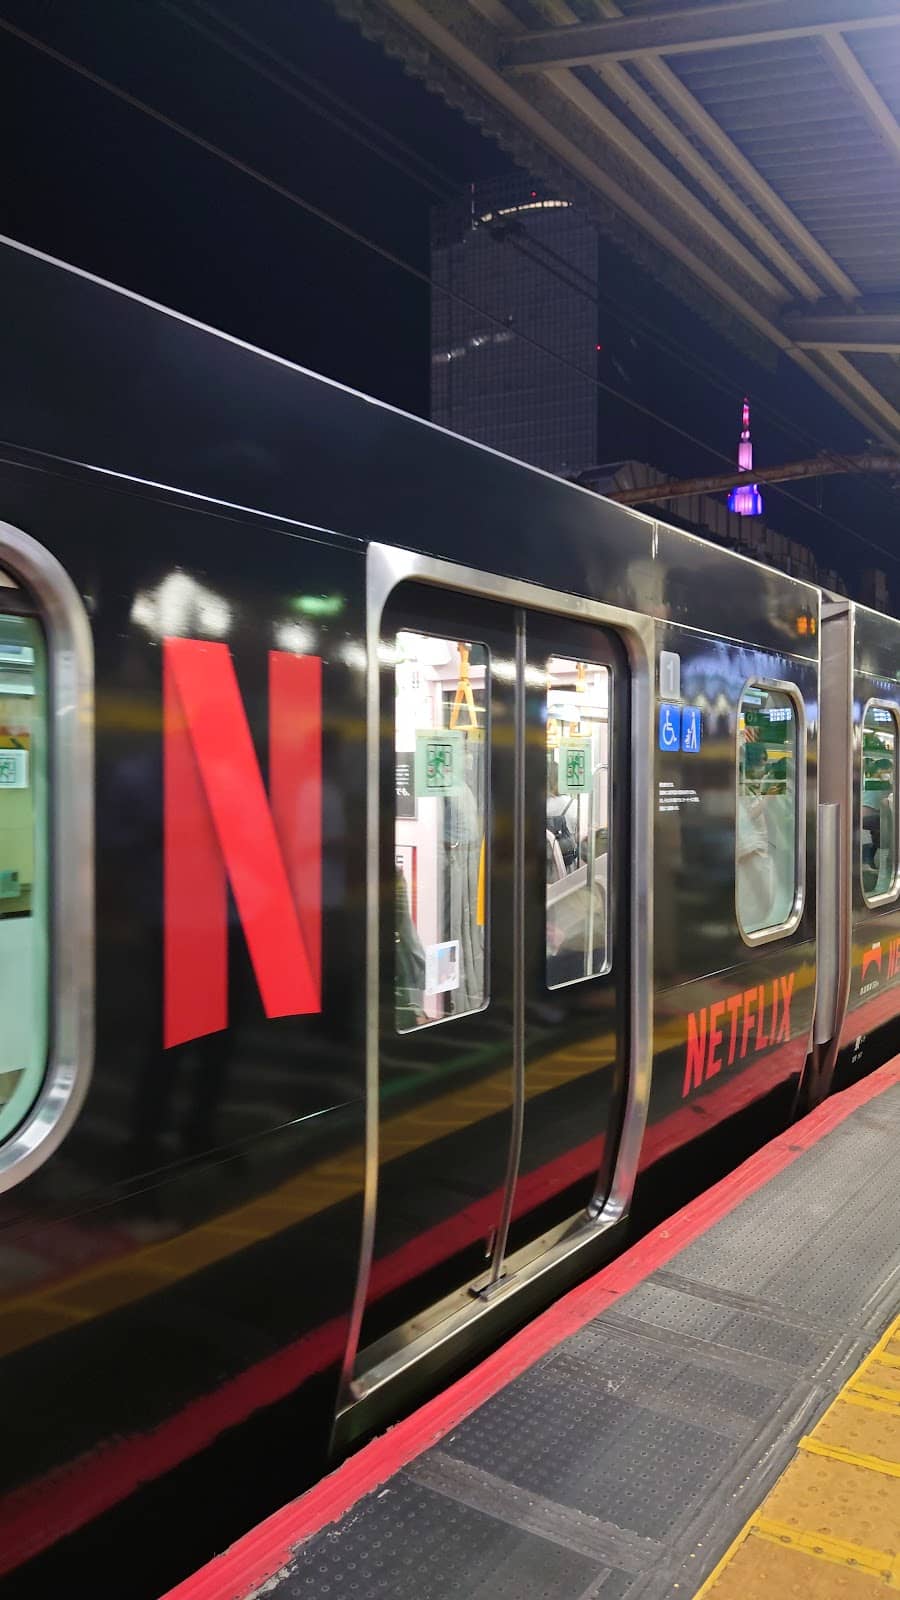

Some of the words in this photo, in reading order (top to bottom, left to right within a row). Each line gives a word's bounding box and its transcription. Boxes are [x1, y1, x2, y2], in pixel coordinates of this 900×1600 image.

[666, 659, 674, 691] 1
[163, 636, 322, 1049] N
[682, 972, 795, 1098] NETFLIX
